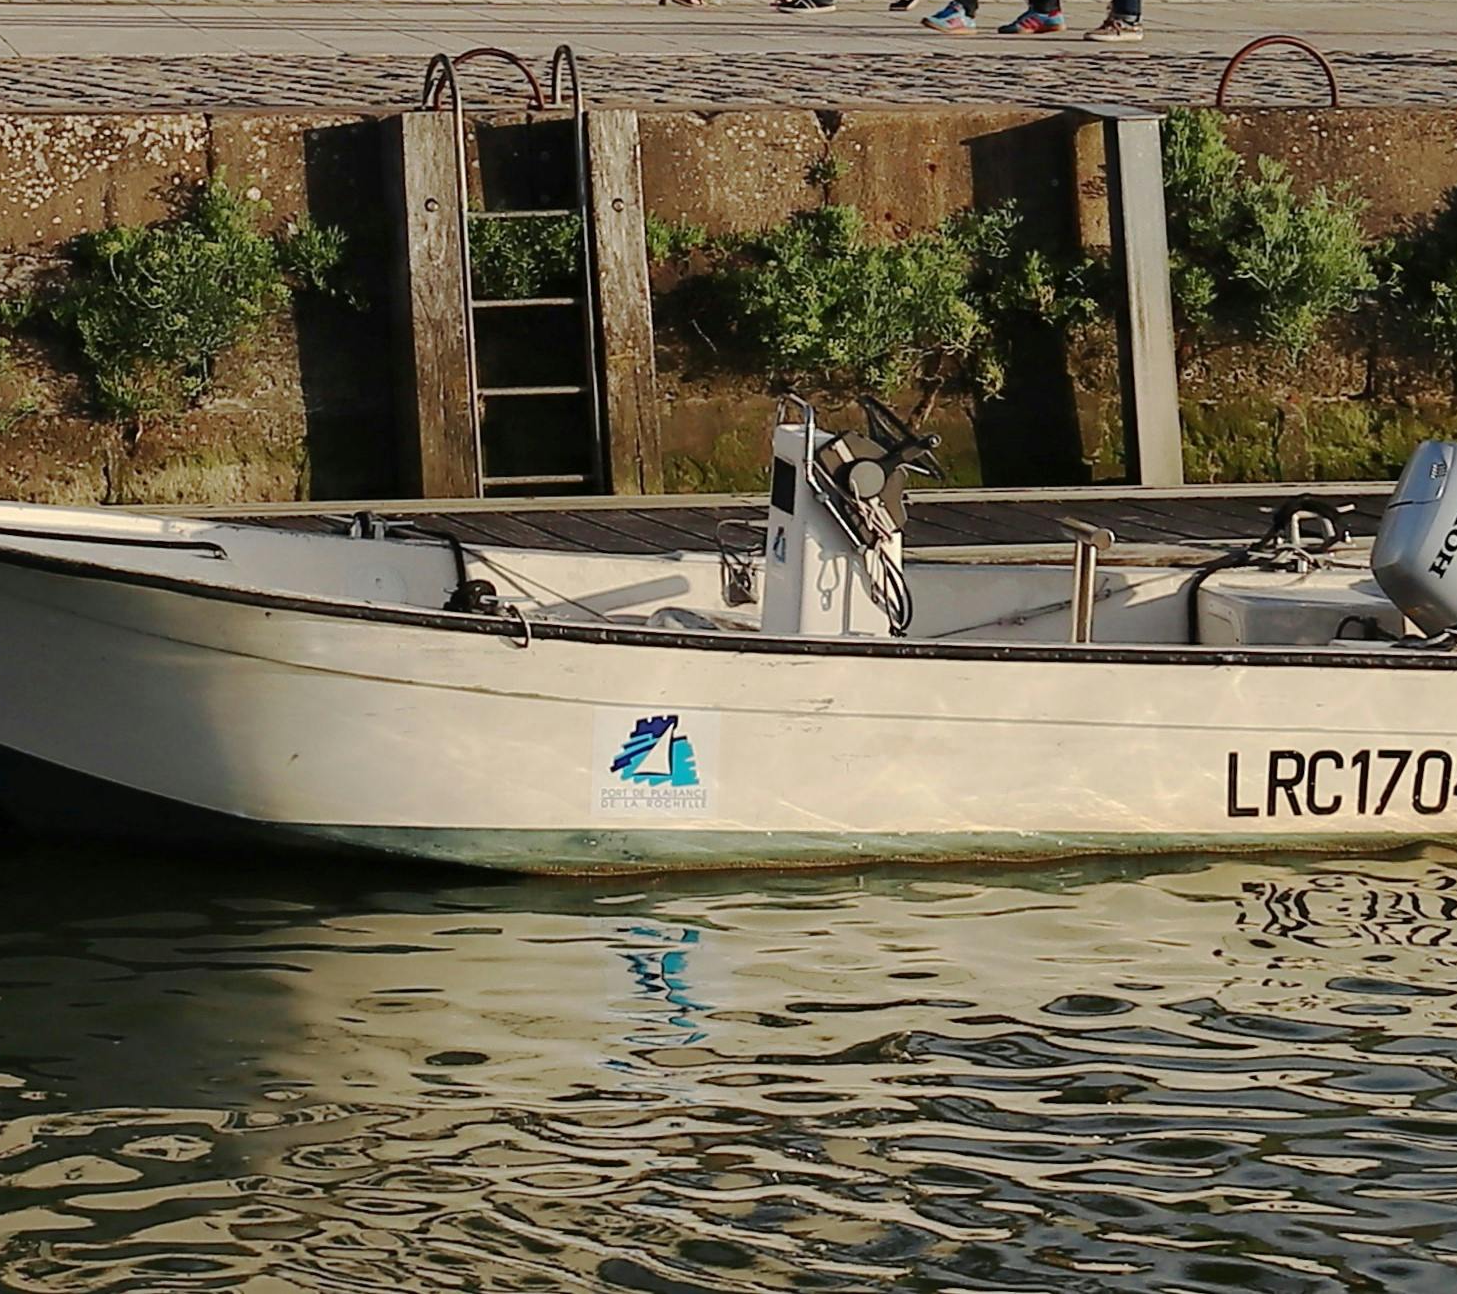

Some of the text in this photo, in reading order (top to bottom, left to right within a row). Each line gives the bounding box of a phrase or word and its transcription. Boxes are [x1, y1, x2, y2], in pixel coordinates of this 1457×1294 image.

[601, 788, 708, 798] PORT DE PLAISANCE
[600, 799, 707, 808] DE LA ROCHELLE
